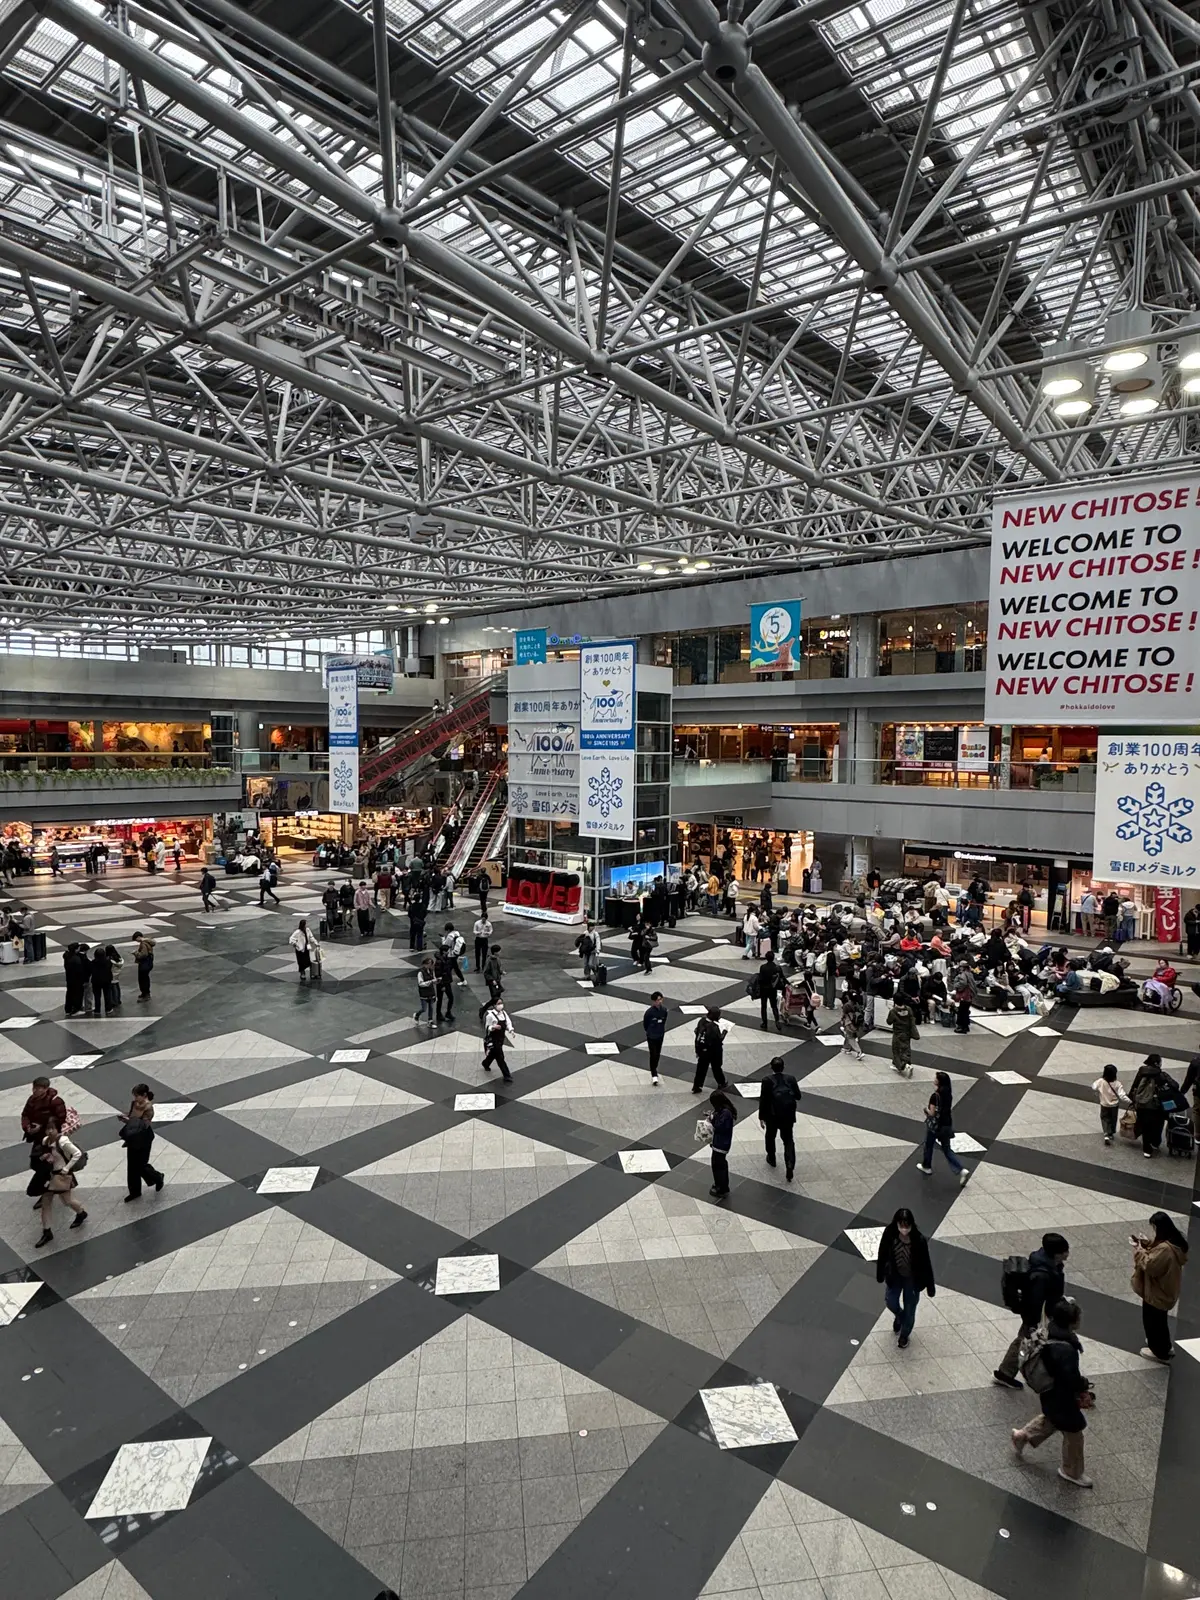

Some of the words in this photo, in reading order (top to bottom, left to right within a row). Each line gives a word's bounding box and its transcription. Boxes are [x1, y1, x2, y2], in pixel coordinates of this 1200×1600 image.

[1002, 503, 1066, 528] NEW
[1071, 487, 1190, 520] CHITOSE
[1002, 528, 1135, 560] WELCOME
[1143, 524, 1182, 546] TO
[1000, 561, 1064, 584] NEW
[1068, 550, 1186, 579] CHITOSE
[1000, 589, 1132, 615] WELCOME
[1141, 585, 1178, 606] TO
[997, 619, 1061, 640] NEW
[1065, 612, 1183, 637] CHITOSE
[585, 652, 629, 664] 創業100周年
[997, 649, 1129, 671] WELCOME
[1137, 646, 1175, 667] TO
[592, 666, 622, 676] ありがとう
[995, 676, 1059, 695] NEW
[1063, 673, 1180, 694] CHITOSE
[1124, 763, 1190, 776] ありがとう
[532, 800, 580, 815] 雪印メグミ
[586, 821, 625, 831] 雪印メグミルク
[1110, 860, 1196, 877] 雪印メグミルク
[530, 909, 547, 918] AIRPORT
